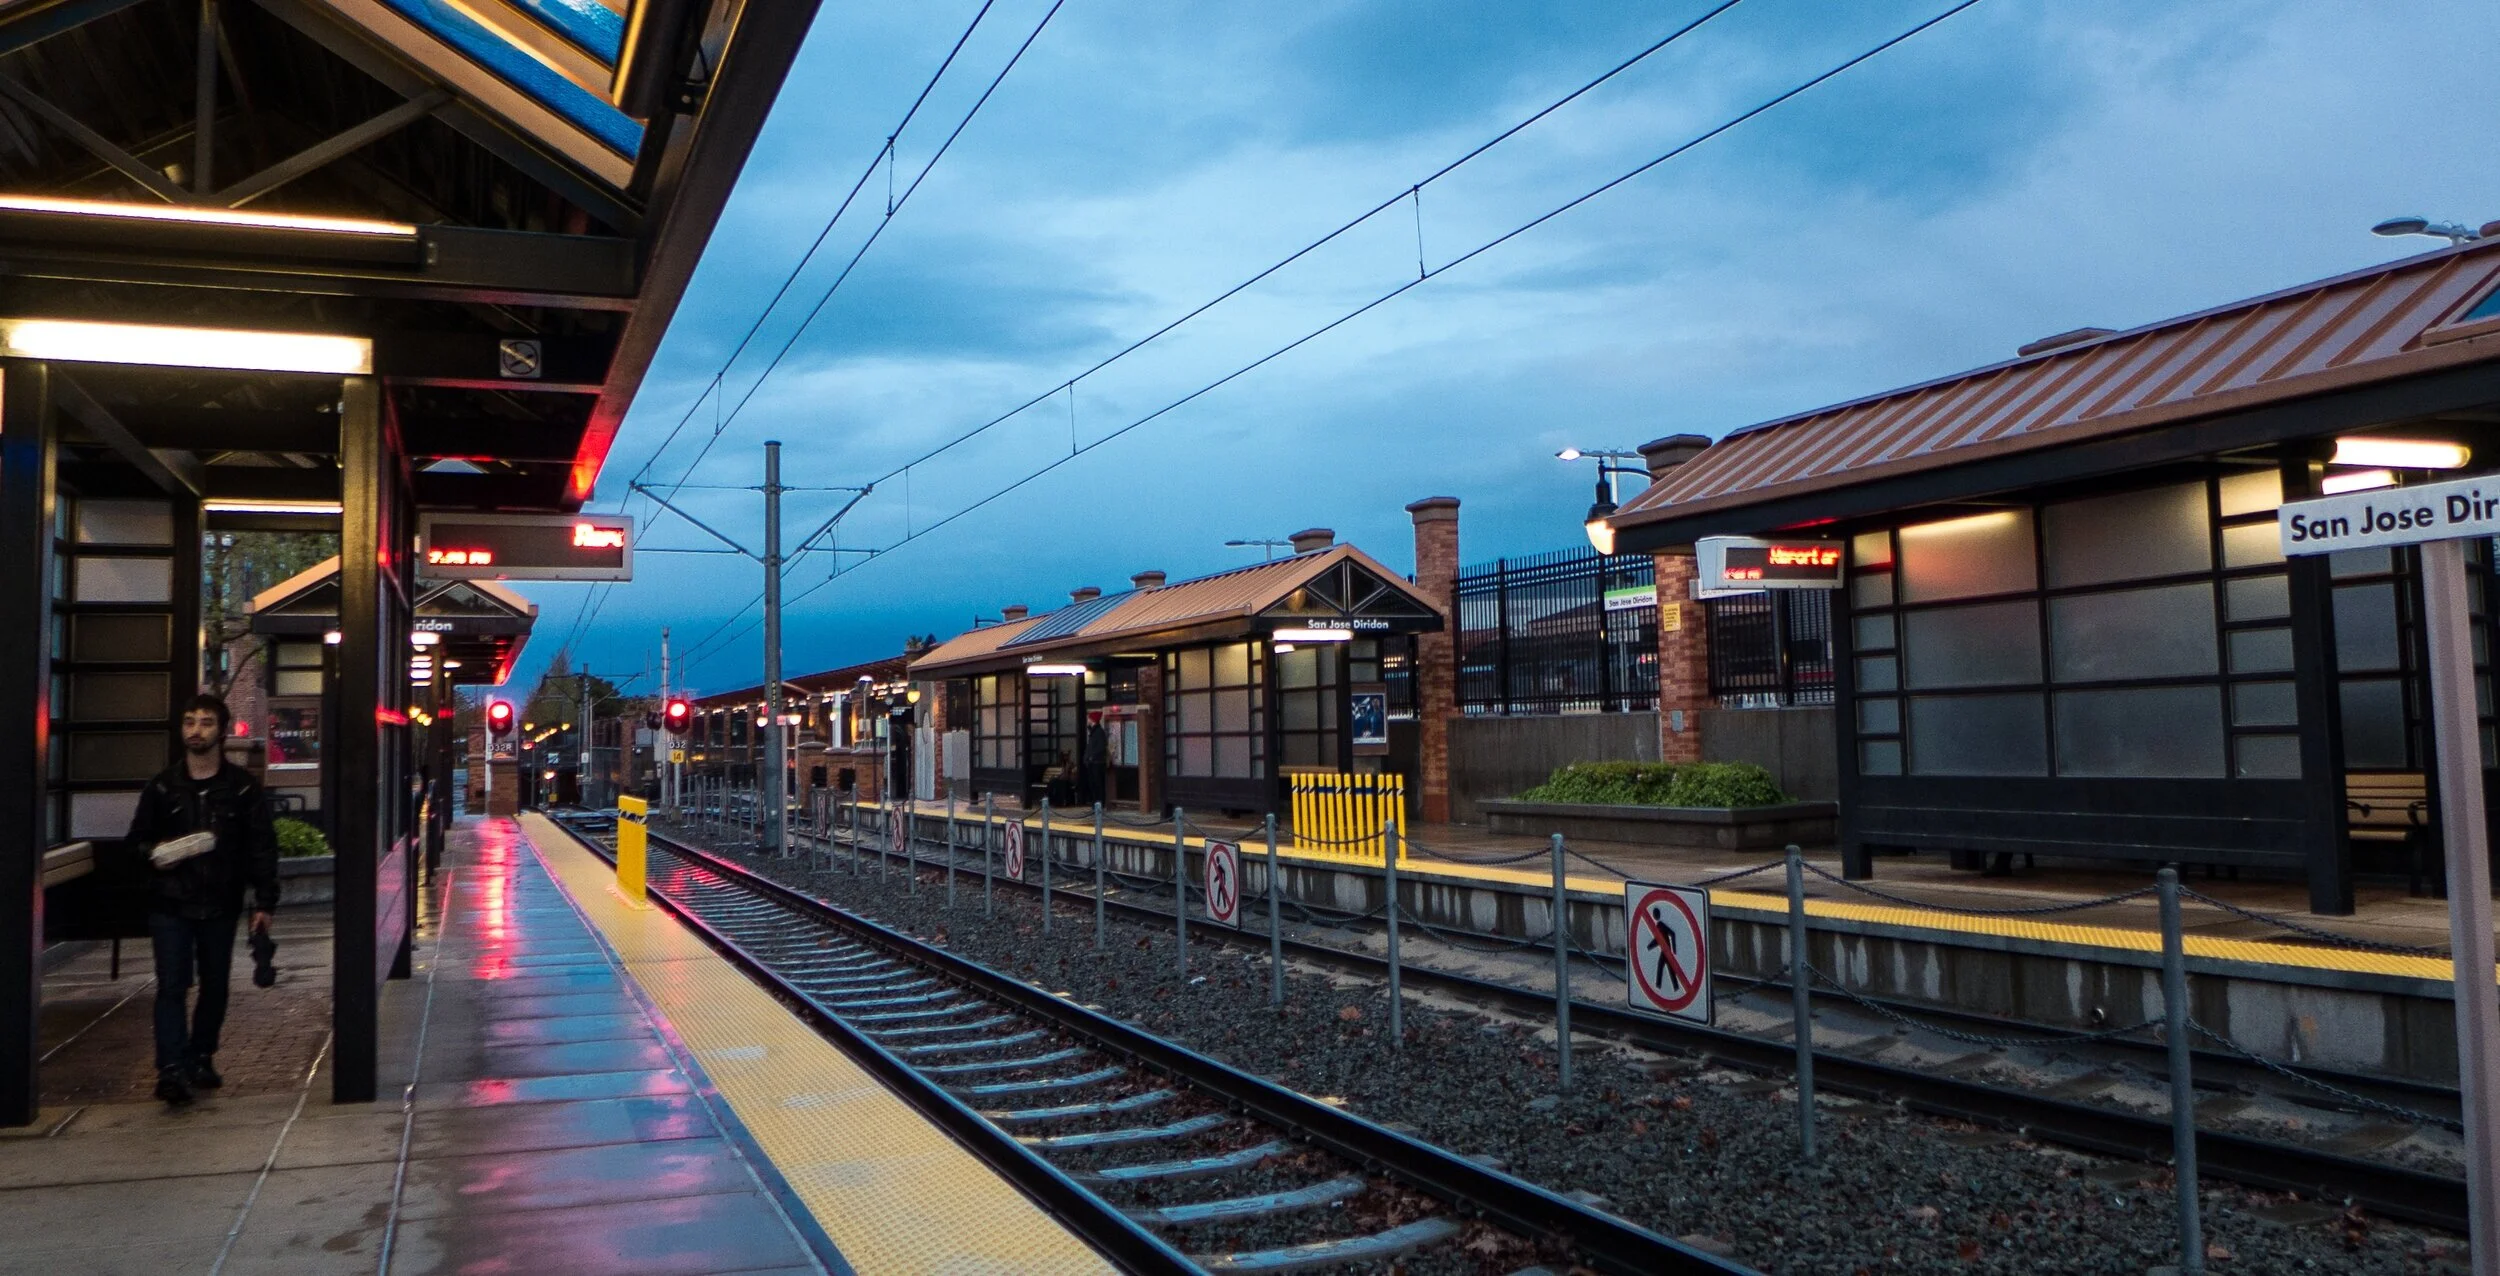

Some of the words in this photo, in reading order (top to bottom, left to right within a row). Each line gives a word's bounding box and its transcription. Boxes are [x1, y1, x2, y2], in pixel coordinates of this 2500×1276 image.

[2290, 514, 2349, 542] San
[2360, 505, 2434, 535] Jose
[2446, 490, 2500, 524] Dir
[1608, 600, 1619, 608] San
[1633, 596, 1653, 604] Diridon
[1307, 619, 1327, 629] San
[1329, 619, 1351, 629] Jose
[1353, 618, 1389, 629] Diridon
[670, 741, 686, 749] D32
